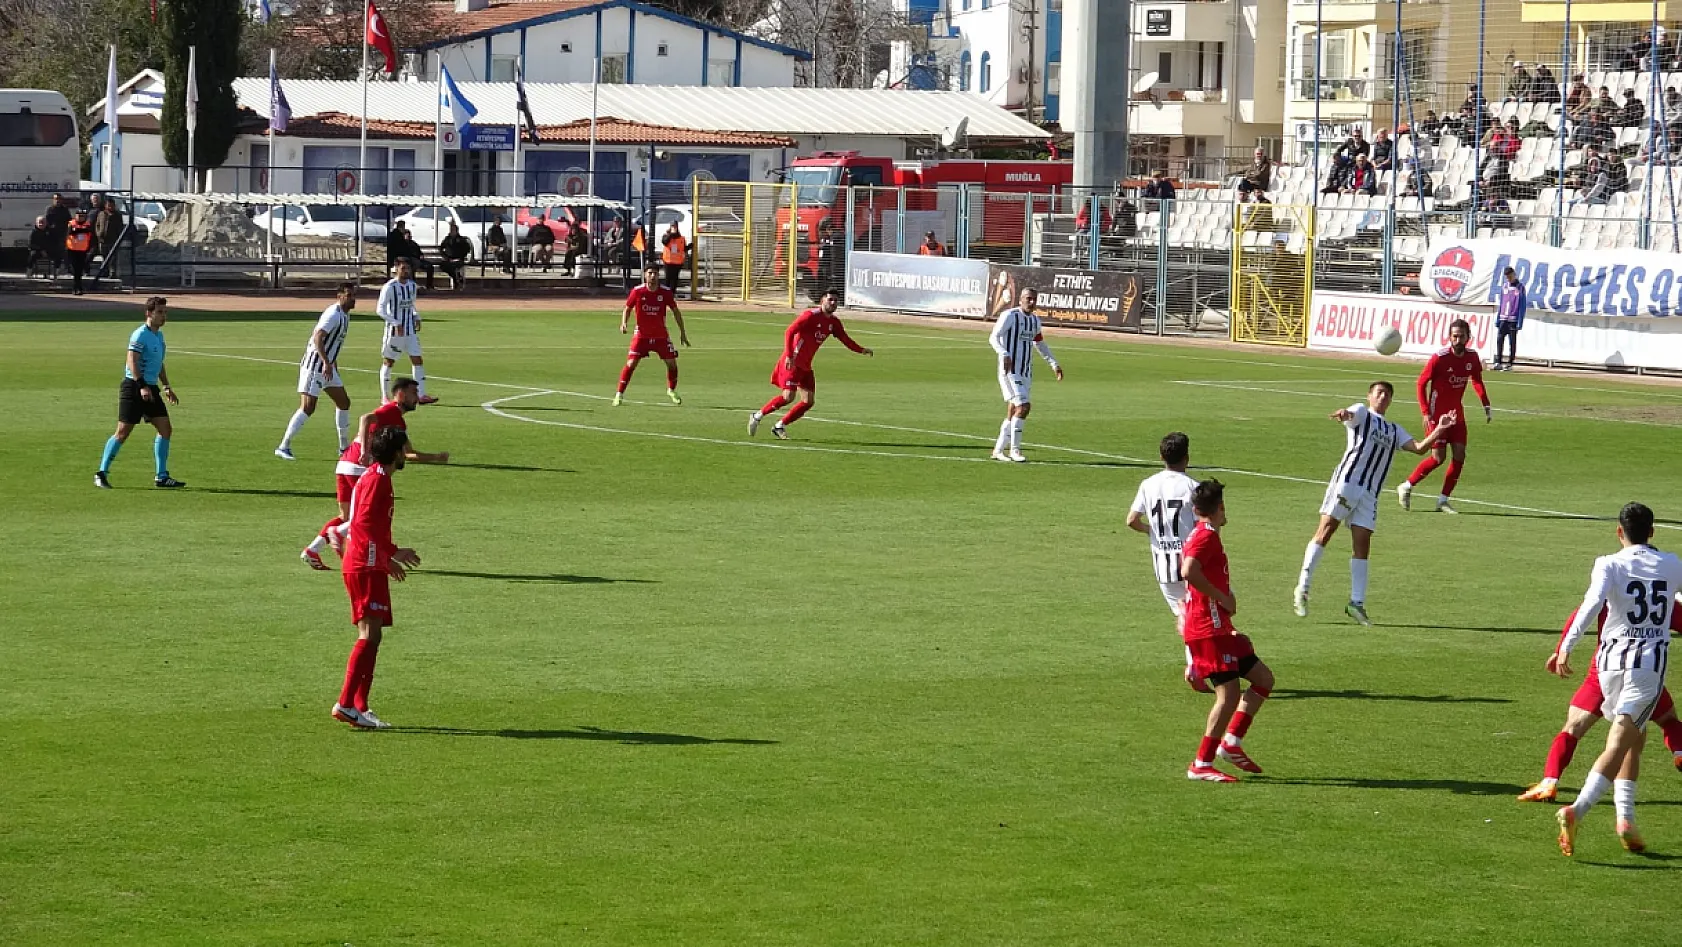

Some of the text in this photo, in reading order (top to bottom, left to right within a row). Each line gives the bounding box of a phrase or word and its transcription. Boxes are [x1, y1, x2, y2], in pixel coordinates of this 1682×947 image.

[1005, 171, 1041, 182] MUĞLA
[1054, 272, 1094, 290] FETHİYE
[1488, 253, 1646, 317] APACHES
[1074, 292, 1119, 312] DÜNYASI
[1405, 309, 1491, 350] KOYUCU
[1152, 499, 1183, 537] 17
[1626, 579, 1668, 626] 35
